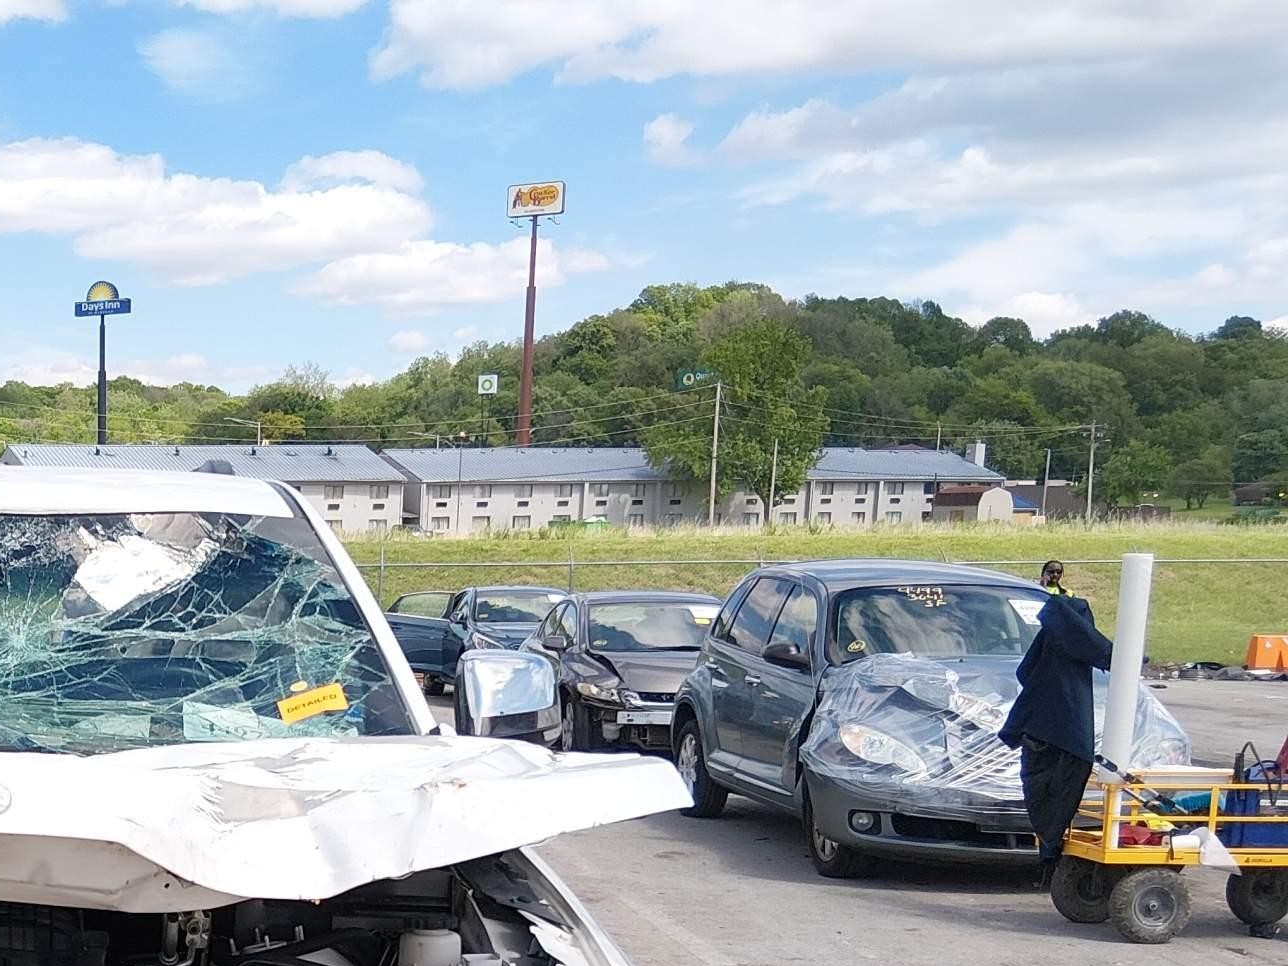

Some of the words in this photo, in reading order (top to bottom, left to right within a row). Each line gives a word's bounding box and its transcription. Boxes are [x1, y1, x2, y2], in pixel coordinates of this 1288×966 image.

[81, 302, 105, 312] Days
[104, 300, 121, 310] Inn
[287, 693, 338, 714] DETAILED
